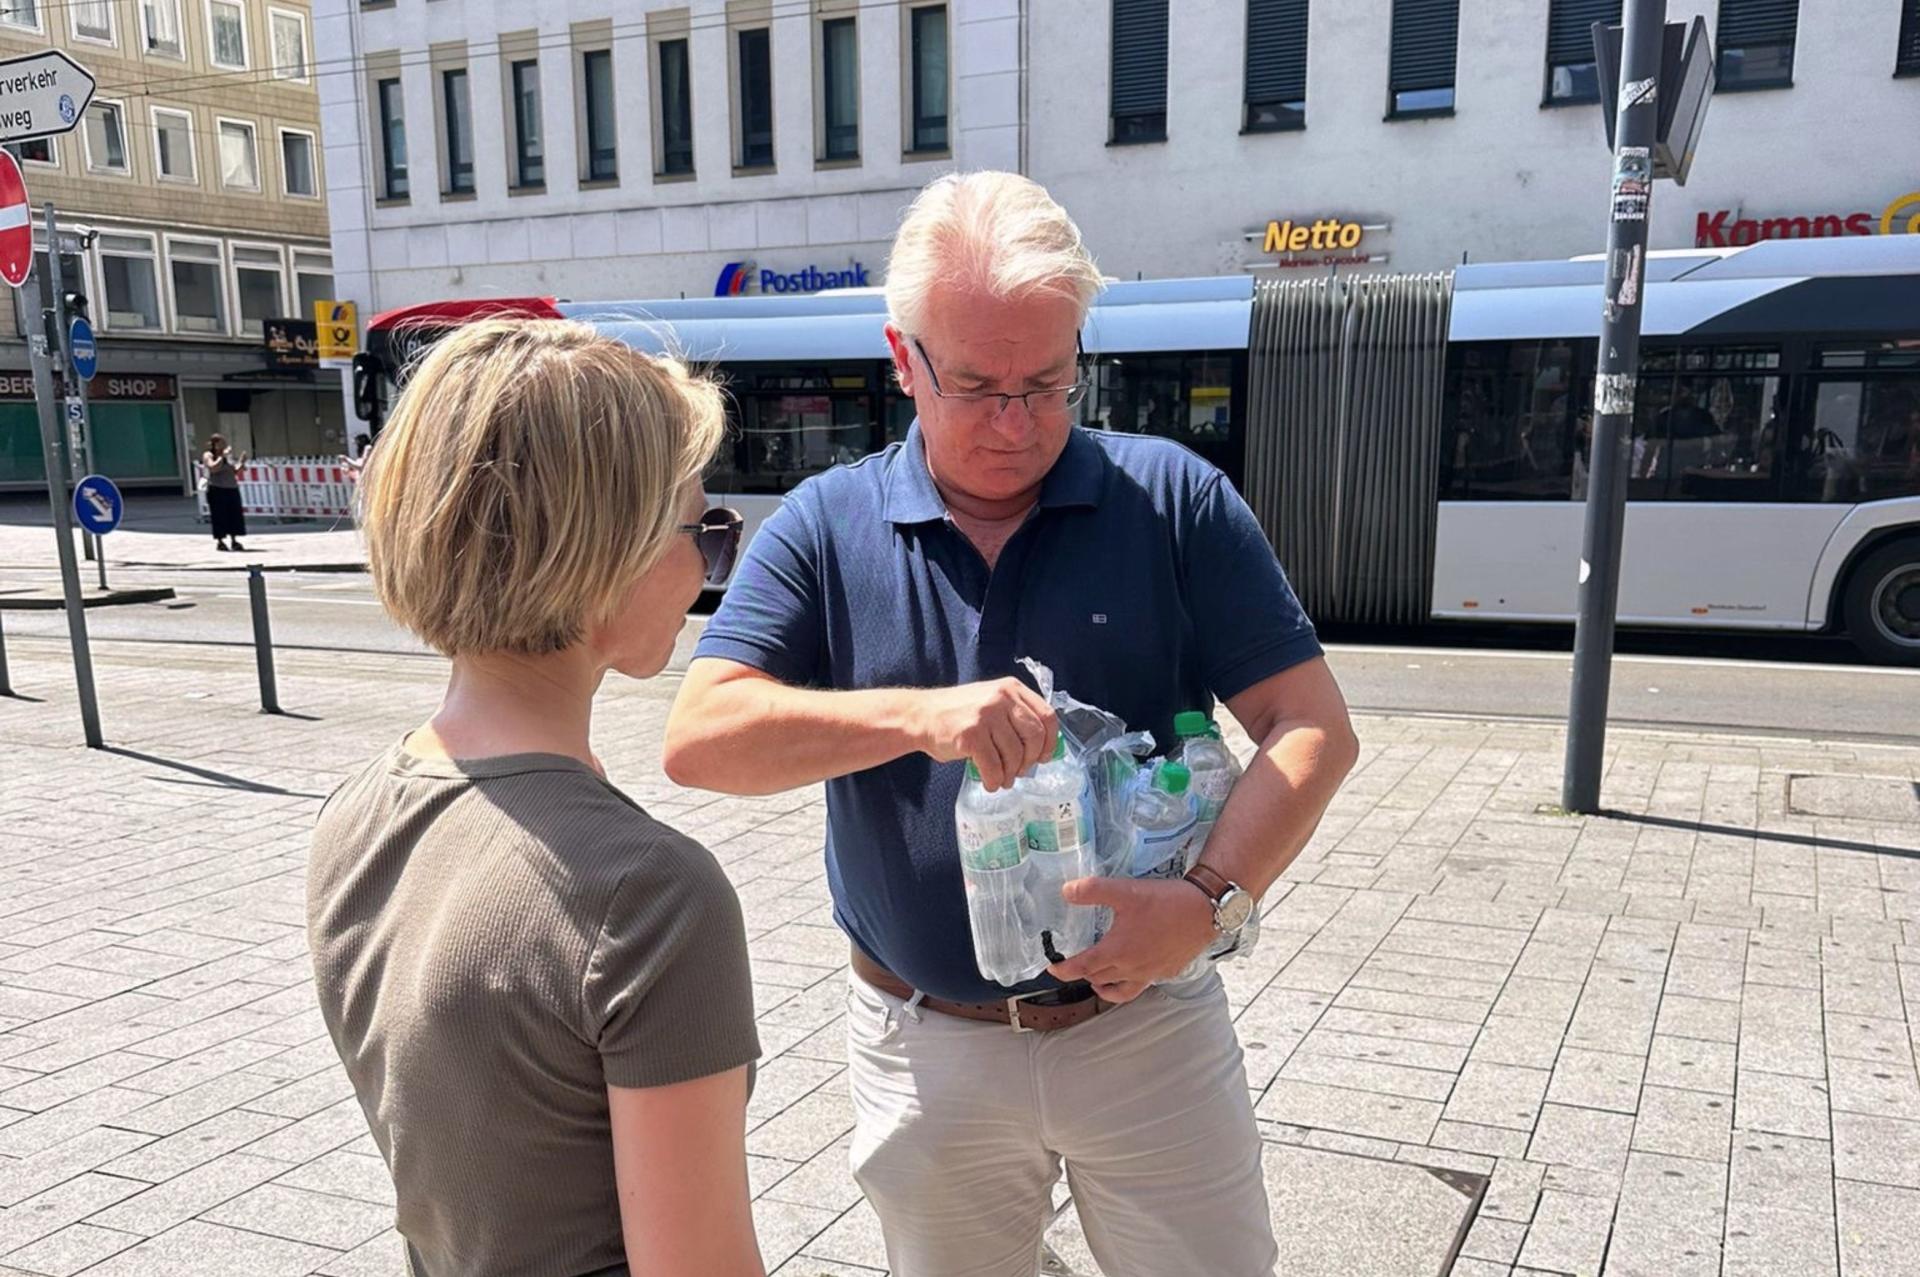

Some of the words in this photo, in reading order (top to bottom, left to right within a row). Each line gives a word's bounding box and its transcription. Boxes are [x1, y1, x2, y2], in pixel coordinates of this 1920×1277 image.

[0, 110, 32, 130] weg
[1263, 218, 1363, 253] Netto
[760, 262, 870, 293] Postbank
[107, 379, 157, 396] SHOP
